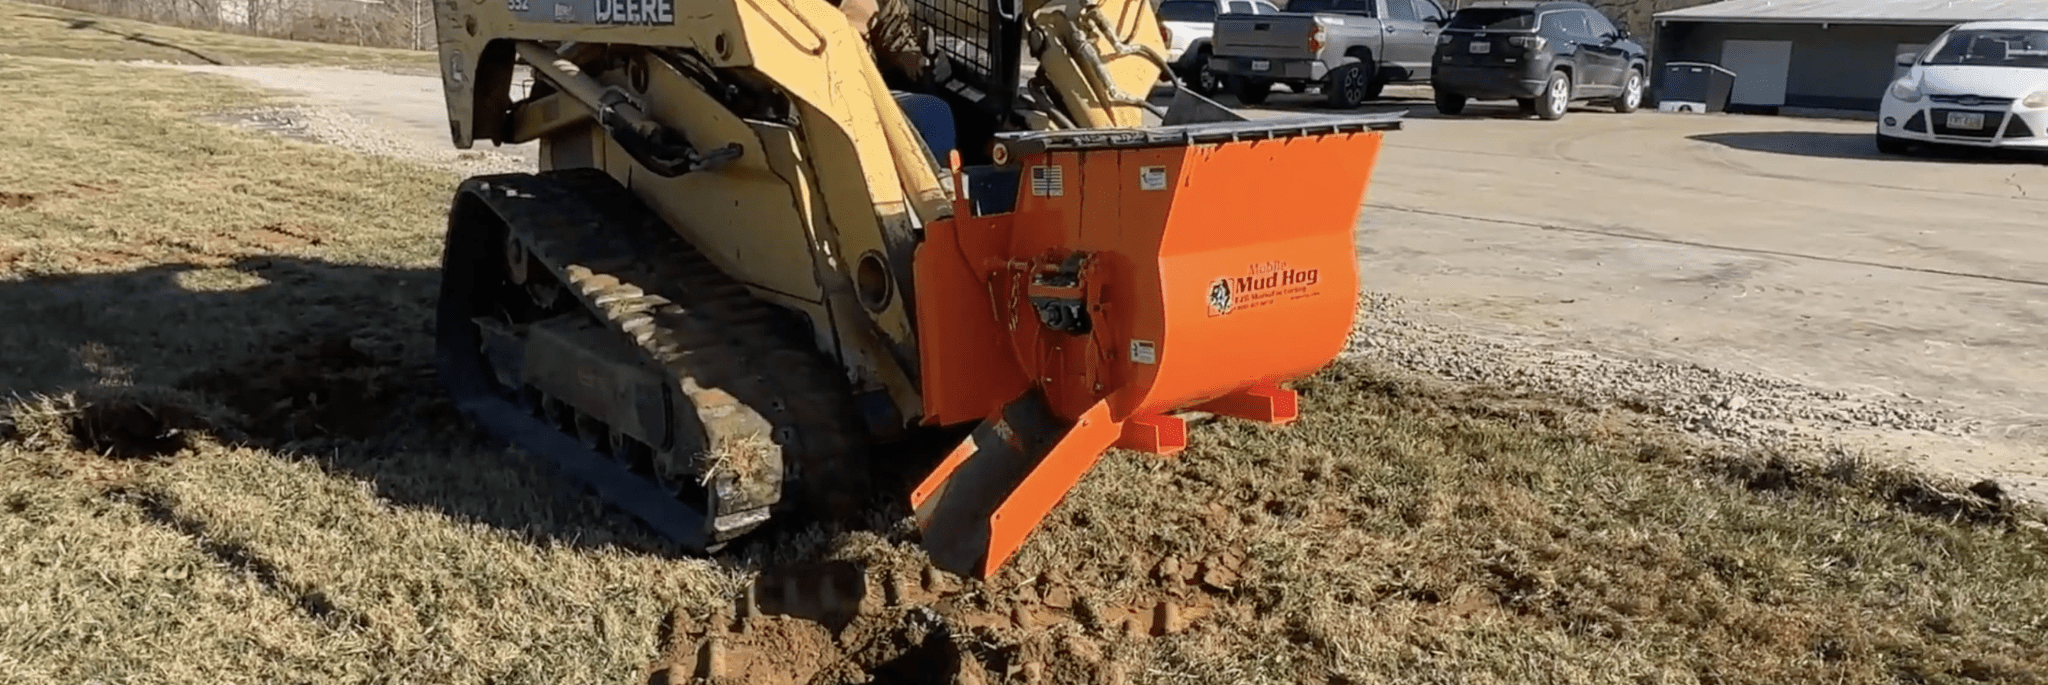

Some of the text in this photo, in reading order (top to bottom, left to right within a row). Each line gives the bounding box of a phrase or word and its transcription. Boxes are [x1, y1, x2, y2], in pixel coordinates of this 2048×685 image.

[596, 0, 674, 22] DEERE
[1235, 269, 1318, 293] Mud Hog
